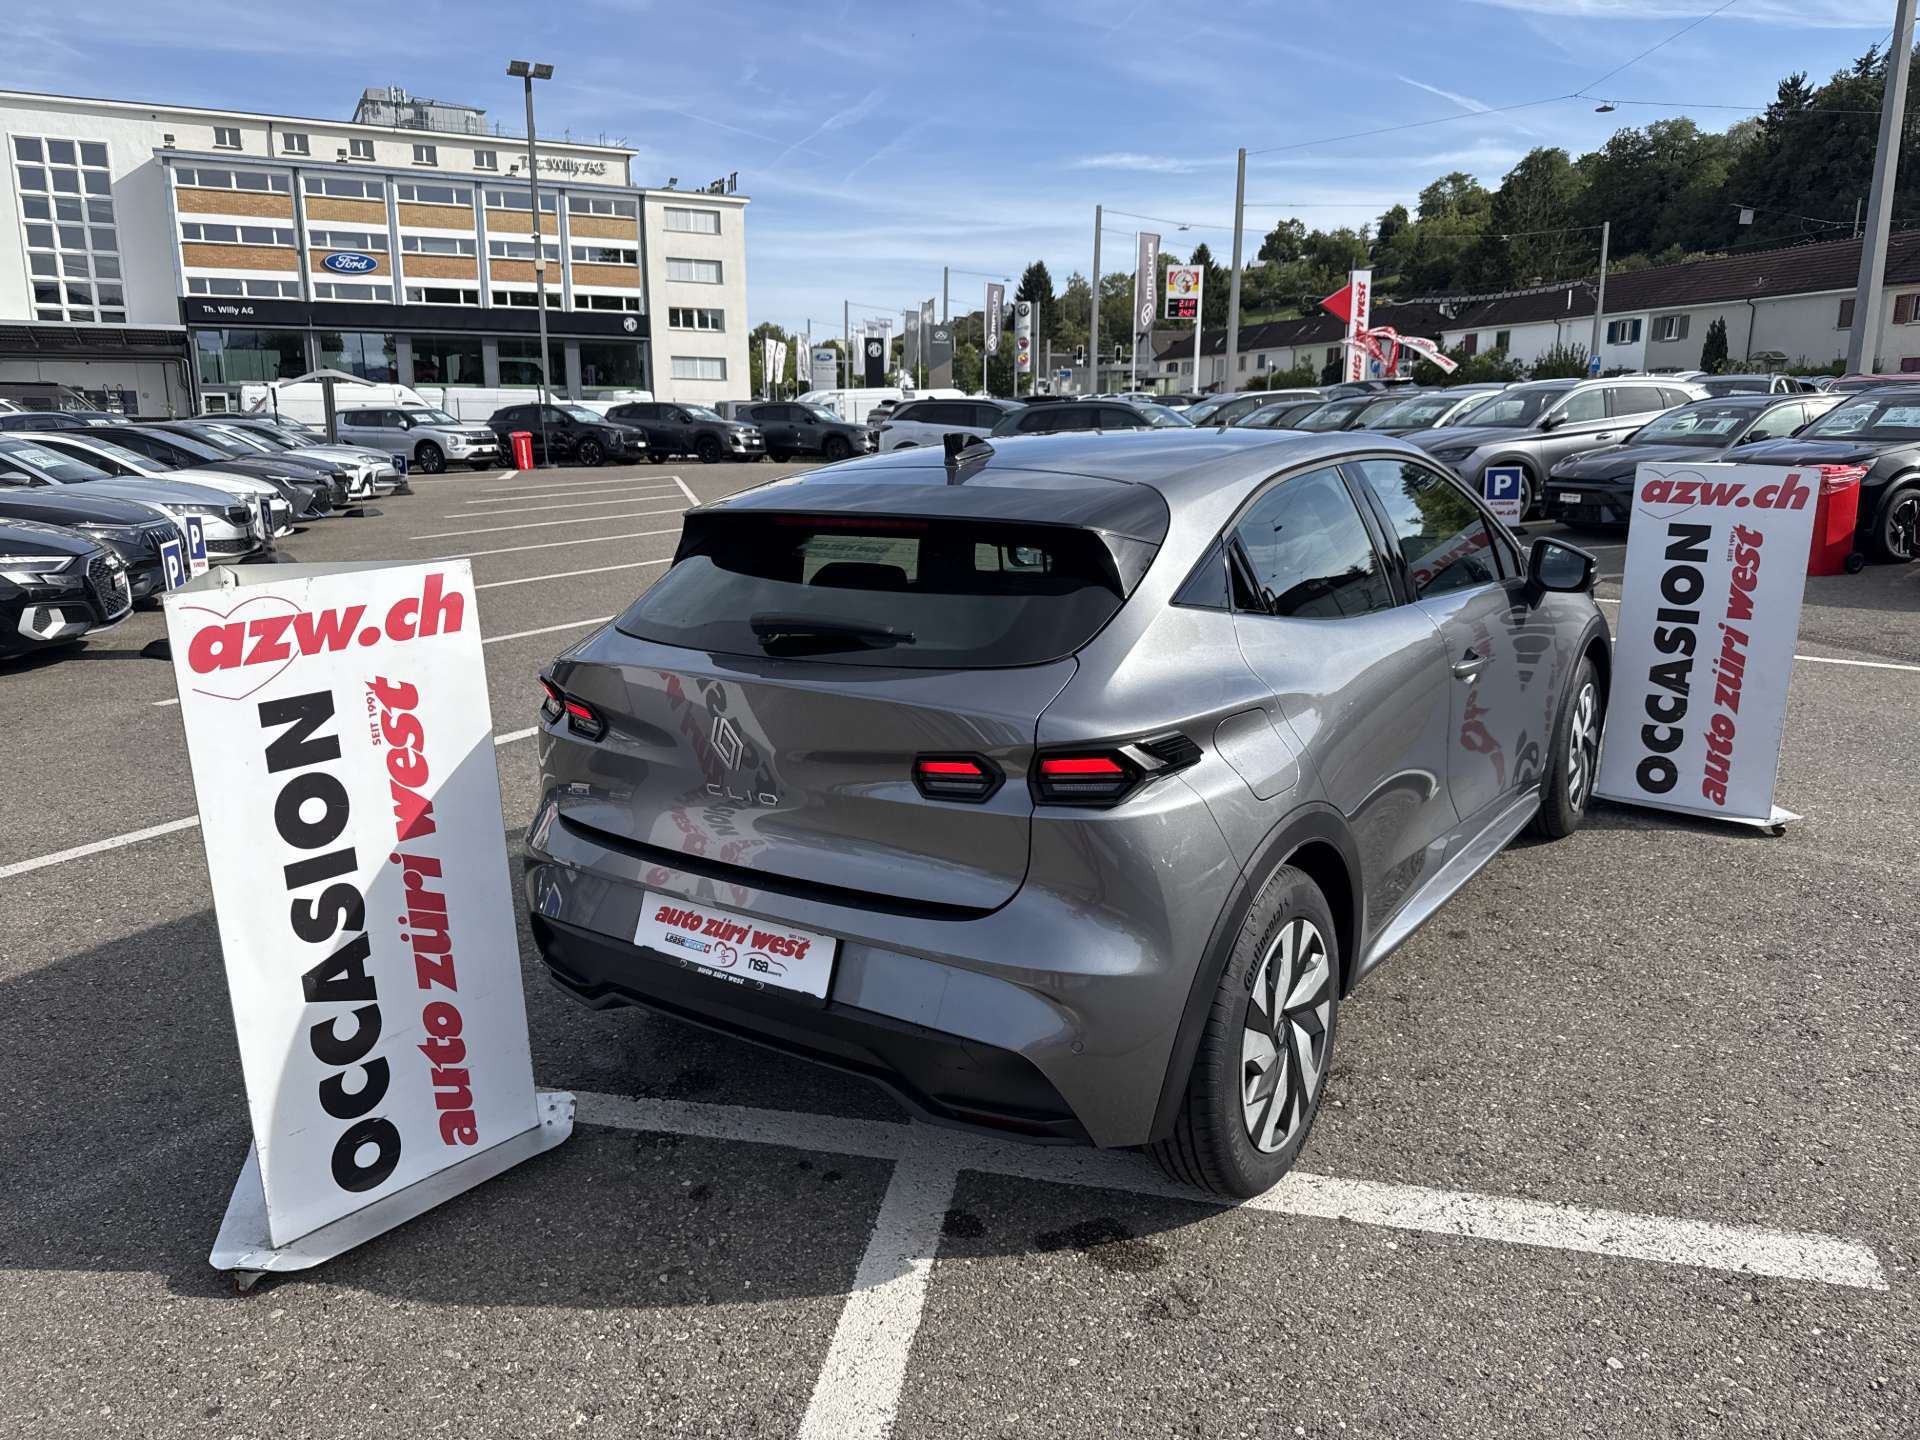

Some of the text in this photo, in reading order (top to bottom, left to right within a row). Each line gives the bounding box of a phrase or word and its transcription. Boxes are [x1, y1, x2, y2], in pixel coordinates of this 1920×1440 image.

[335, 256, 367, 270] Ford
[203, 305, 254, 315] Th. Willy AG
[1494, 474, 1512, 496] P
[1641, 474, 1810, 510] azw.ch
[190, 525, 200, 553] P
[168, 556, 179, 589] P
[188, 573, 465, 674] azw.ch
[1636, 523, 1712, 794] OCCASION
[1702, 523, 1764, 806] auto züri west
[365, 690, 381, 746] SEIT 1991
[707, 783, 779, 806] CLIO
[364, 675, 479, 1146] auto züri west
[655, 906, 703, 931] auto
[701, 918, 752, 945] züri
[751, 930, 811, 960] west
[258, 690, 401, 1193] OCCASION
[1244, 903, 1284, 992] Continental
[748, 957, 769, 973] nsa
